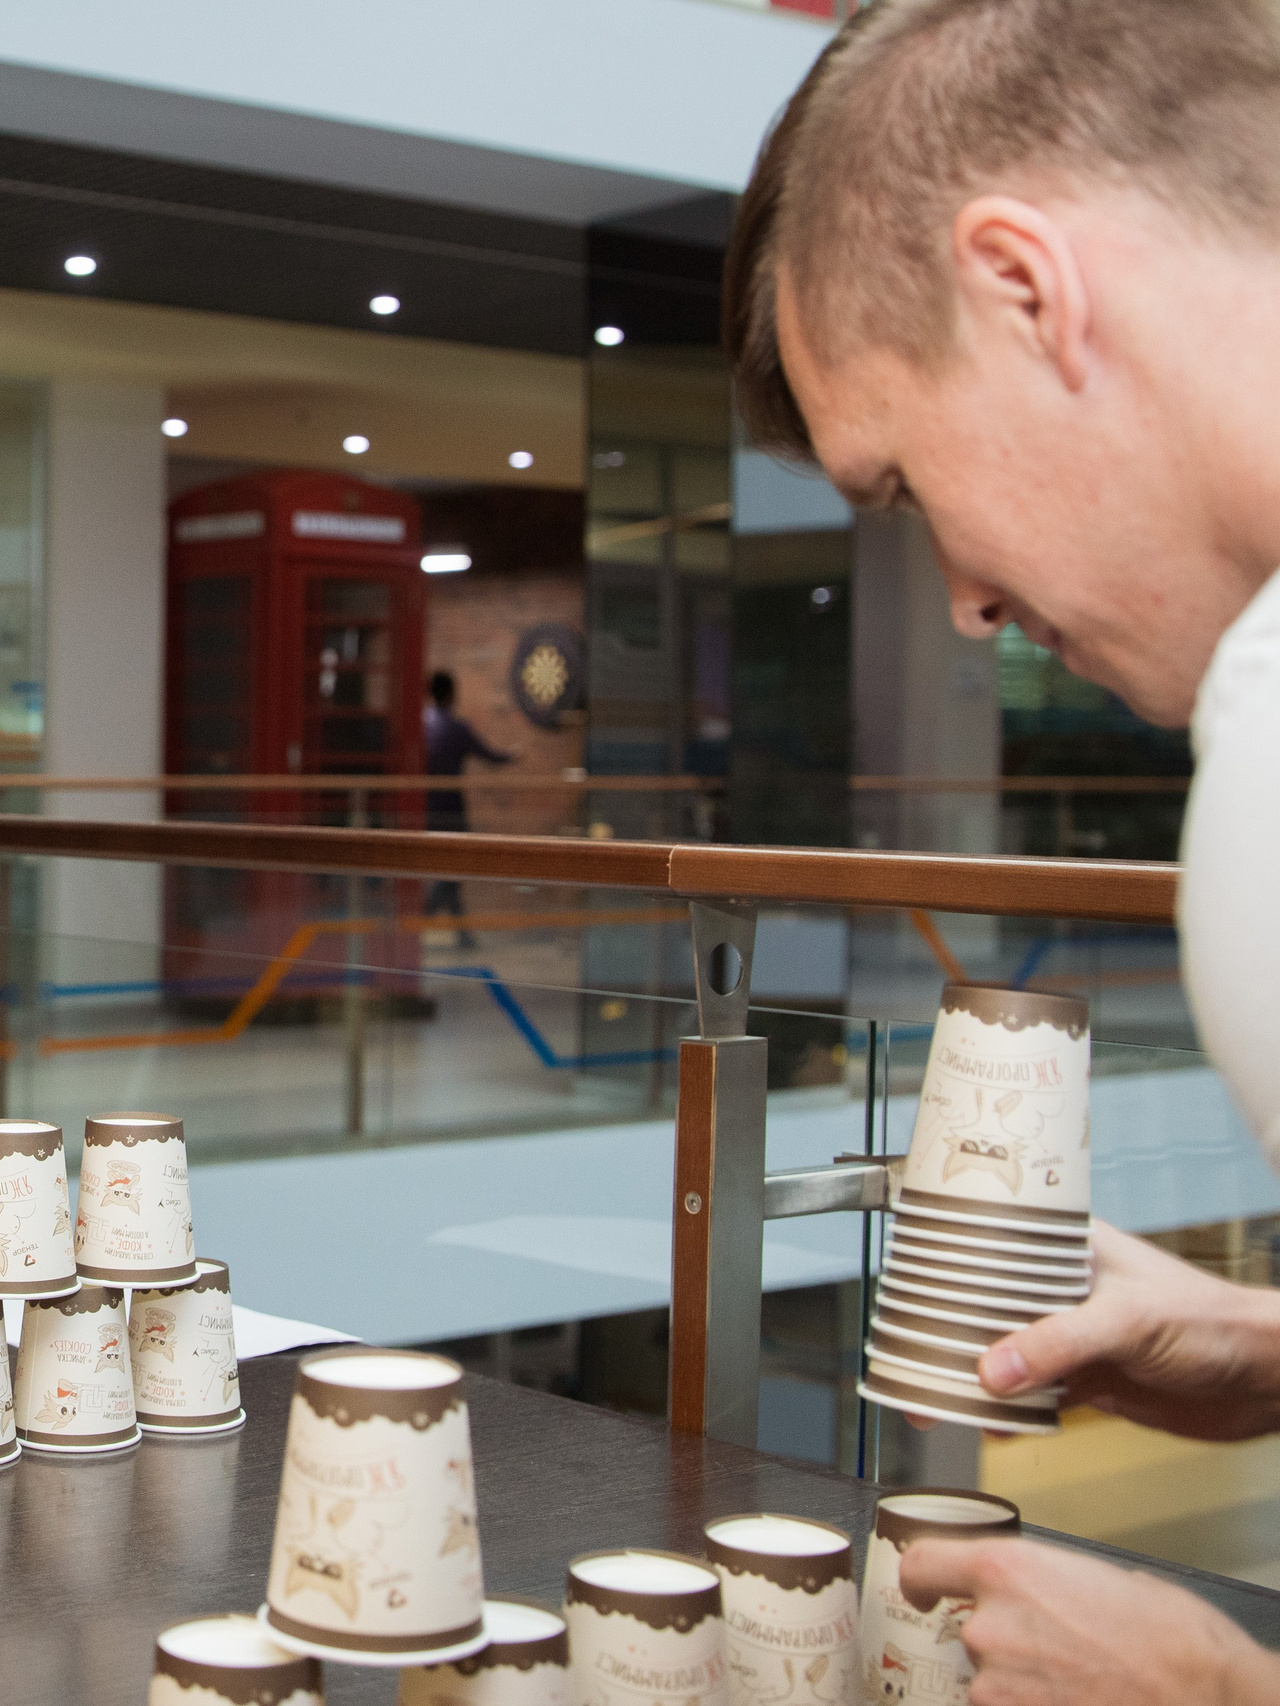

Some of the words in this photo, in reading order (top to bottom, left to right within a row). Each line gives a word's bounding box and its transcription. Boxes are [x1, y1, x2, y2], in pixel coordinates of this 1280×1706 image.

[937, 1047, 1029, 1081] ПРОГРАММИСТ
[12, 1243, 39, 1256] ТЕНЗОР
[132, 1252, 154, 1260] СПЕРВА
[54, 1339, 92, 1354] COOKIES
[57, 1353, 87, 1365] ЗАЧИСТКА
